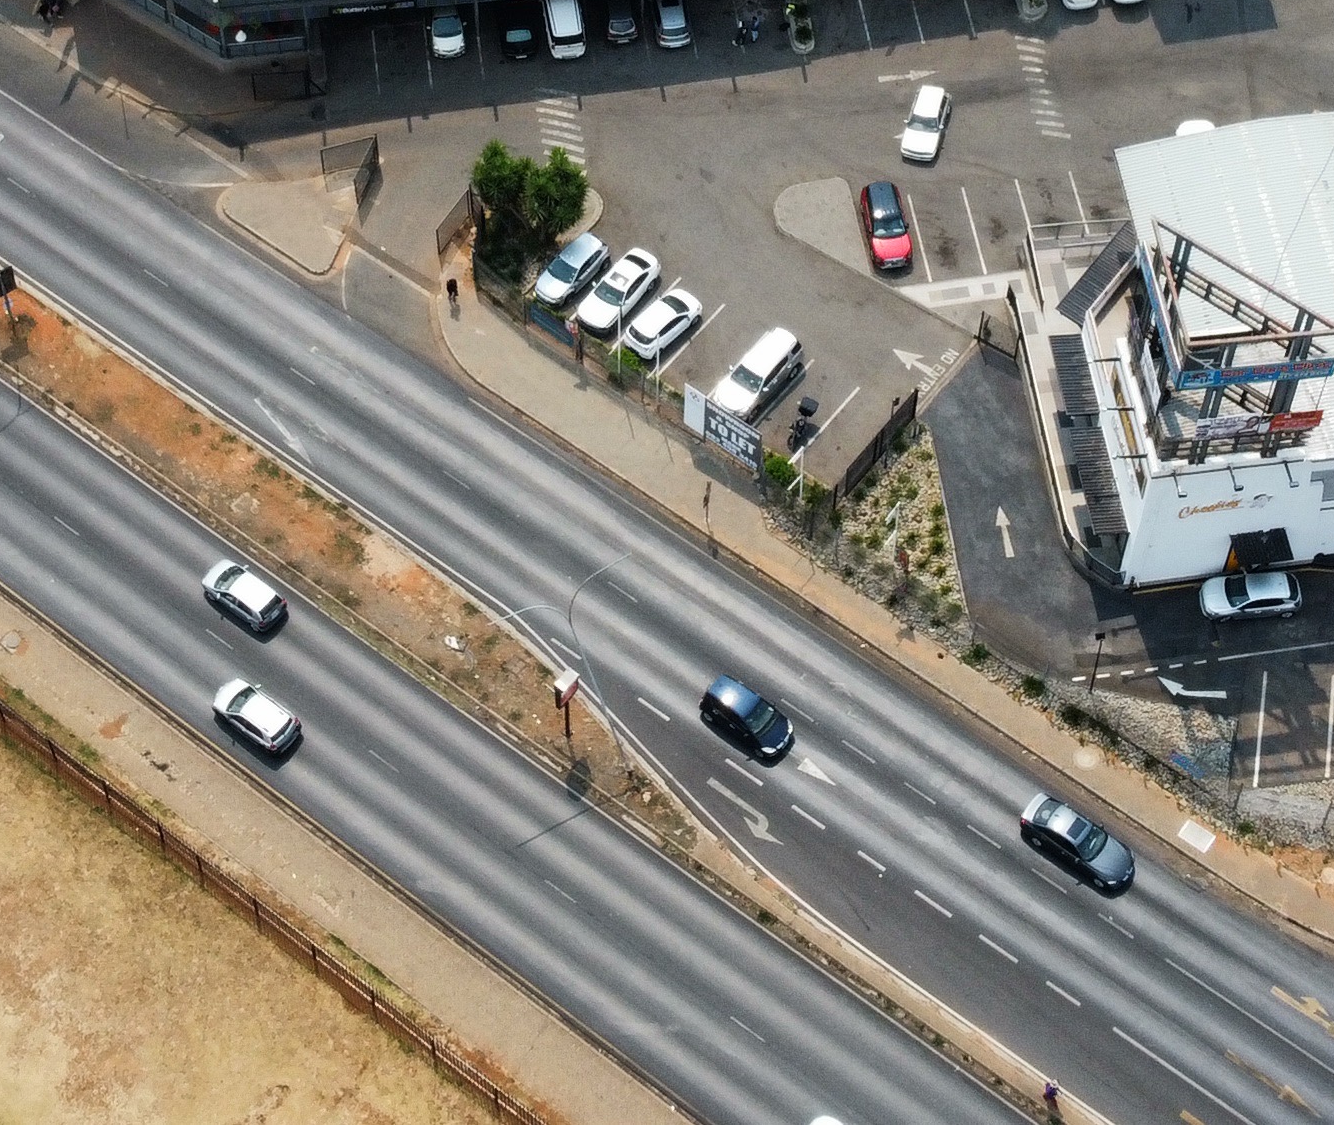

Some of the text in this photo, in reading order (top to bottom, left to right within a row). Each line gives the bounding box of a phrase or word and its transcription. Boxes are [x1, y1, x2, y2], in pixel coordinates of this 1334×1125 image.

[940, 348, 960, 365] NO
[708, 416, 728, 438] TO
[731, 432, 756, 455] LET
